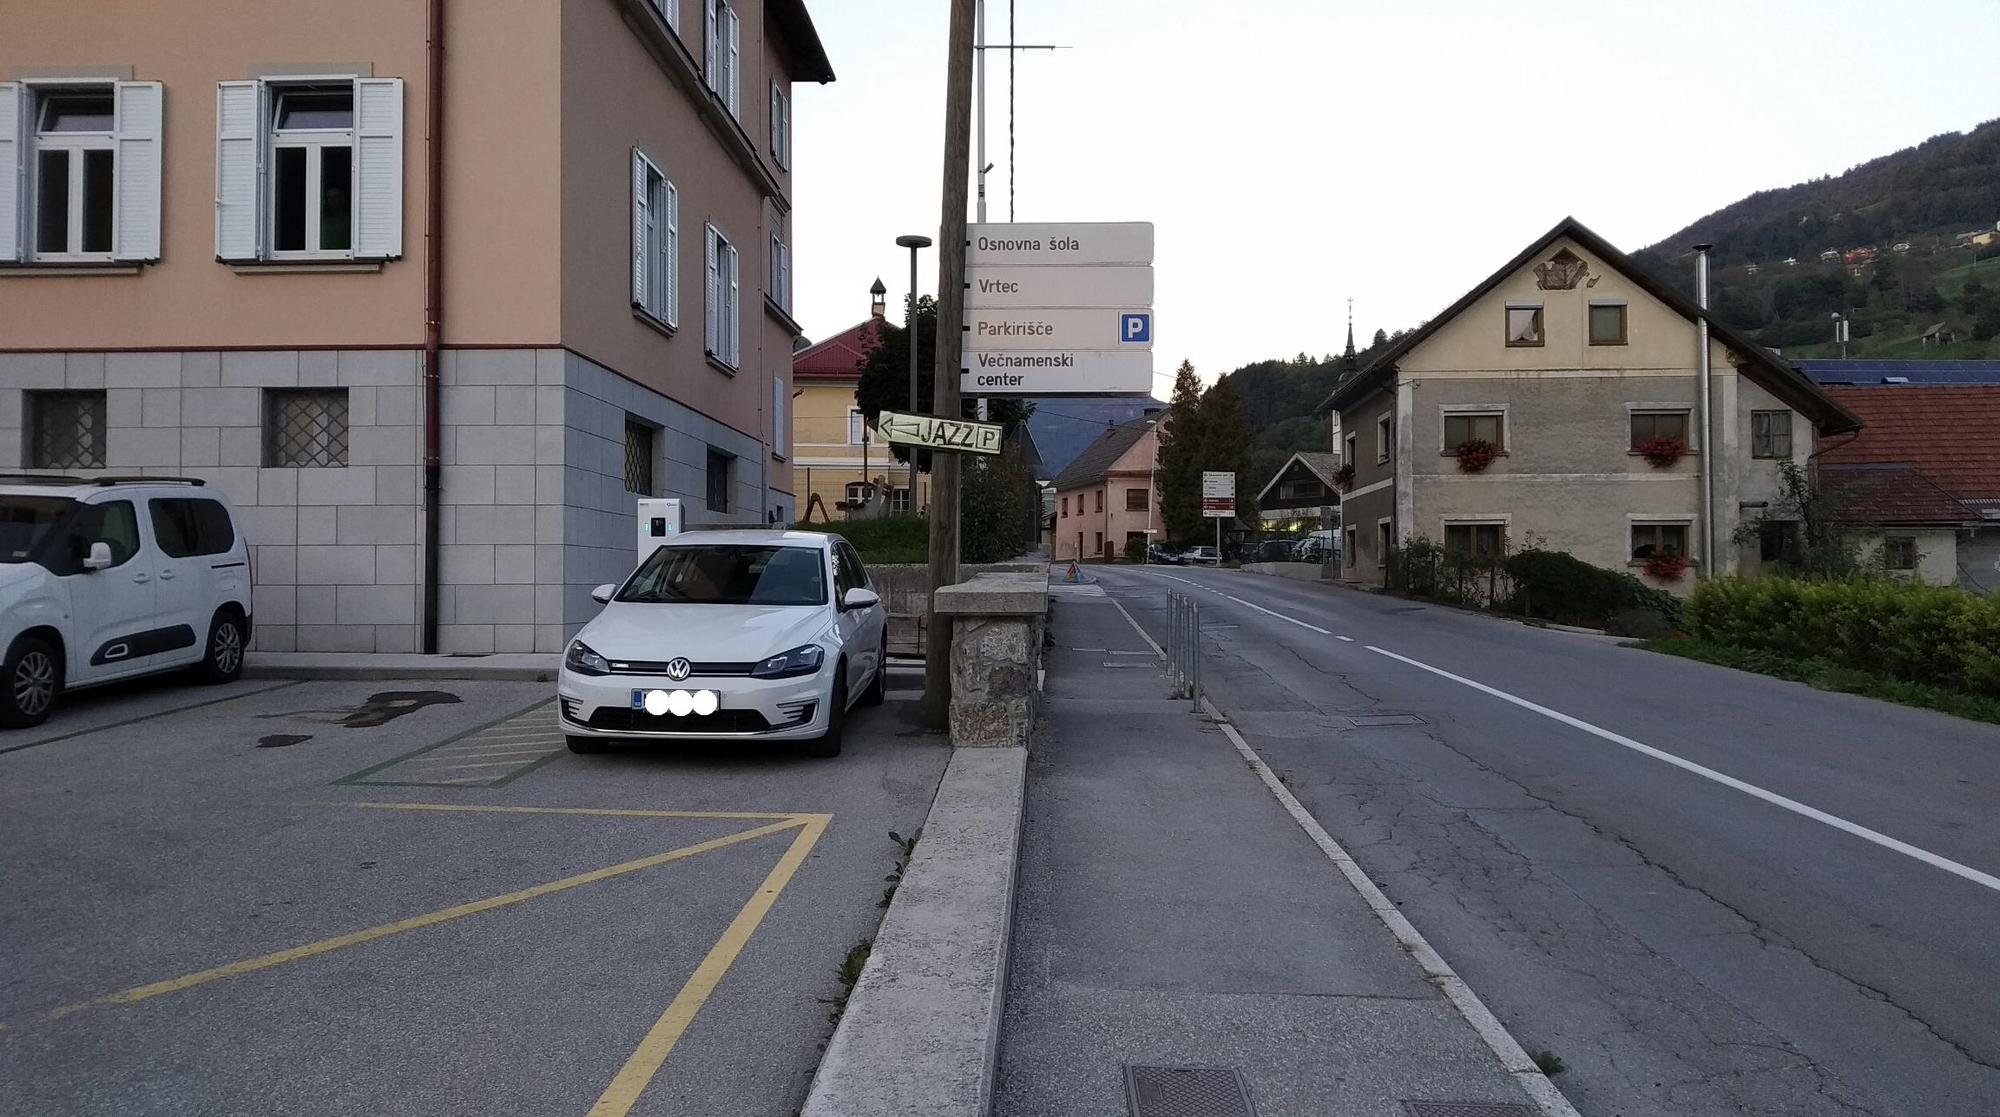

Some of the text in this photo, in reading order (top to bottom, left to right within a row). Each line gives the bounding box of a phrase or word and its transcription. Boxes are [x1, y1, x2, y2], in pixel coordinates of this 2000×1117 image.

[978, 236, 1080, 251] Osnovna šola
[979, 279, 1019, 293] Vrtec
[977, 321, 1053, 336] Parkirišče
[1128, 317, 1143, 339] P
[978, 353, 1074, 368] Večnamenski
[977, 372, 1024, 386] center
[920, 420, 996, 448] JAZZ P
